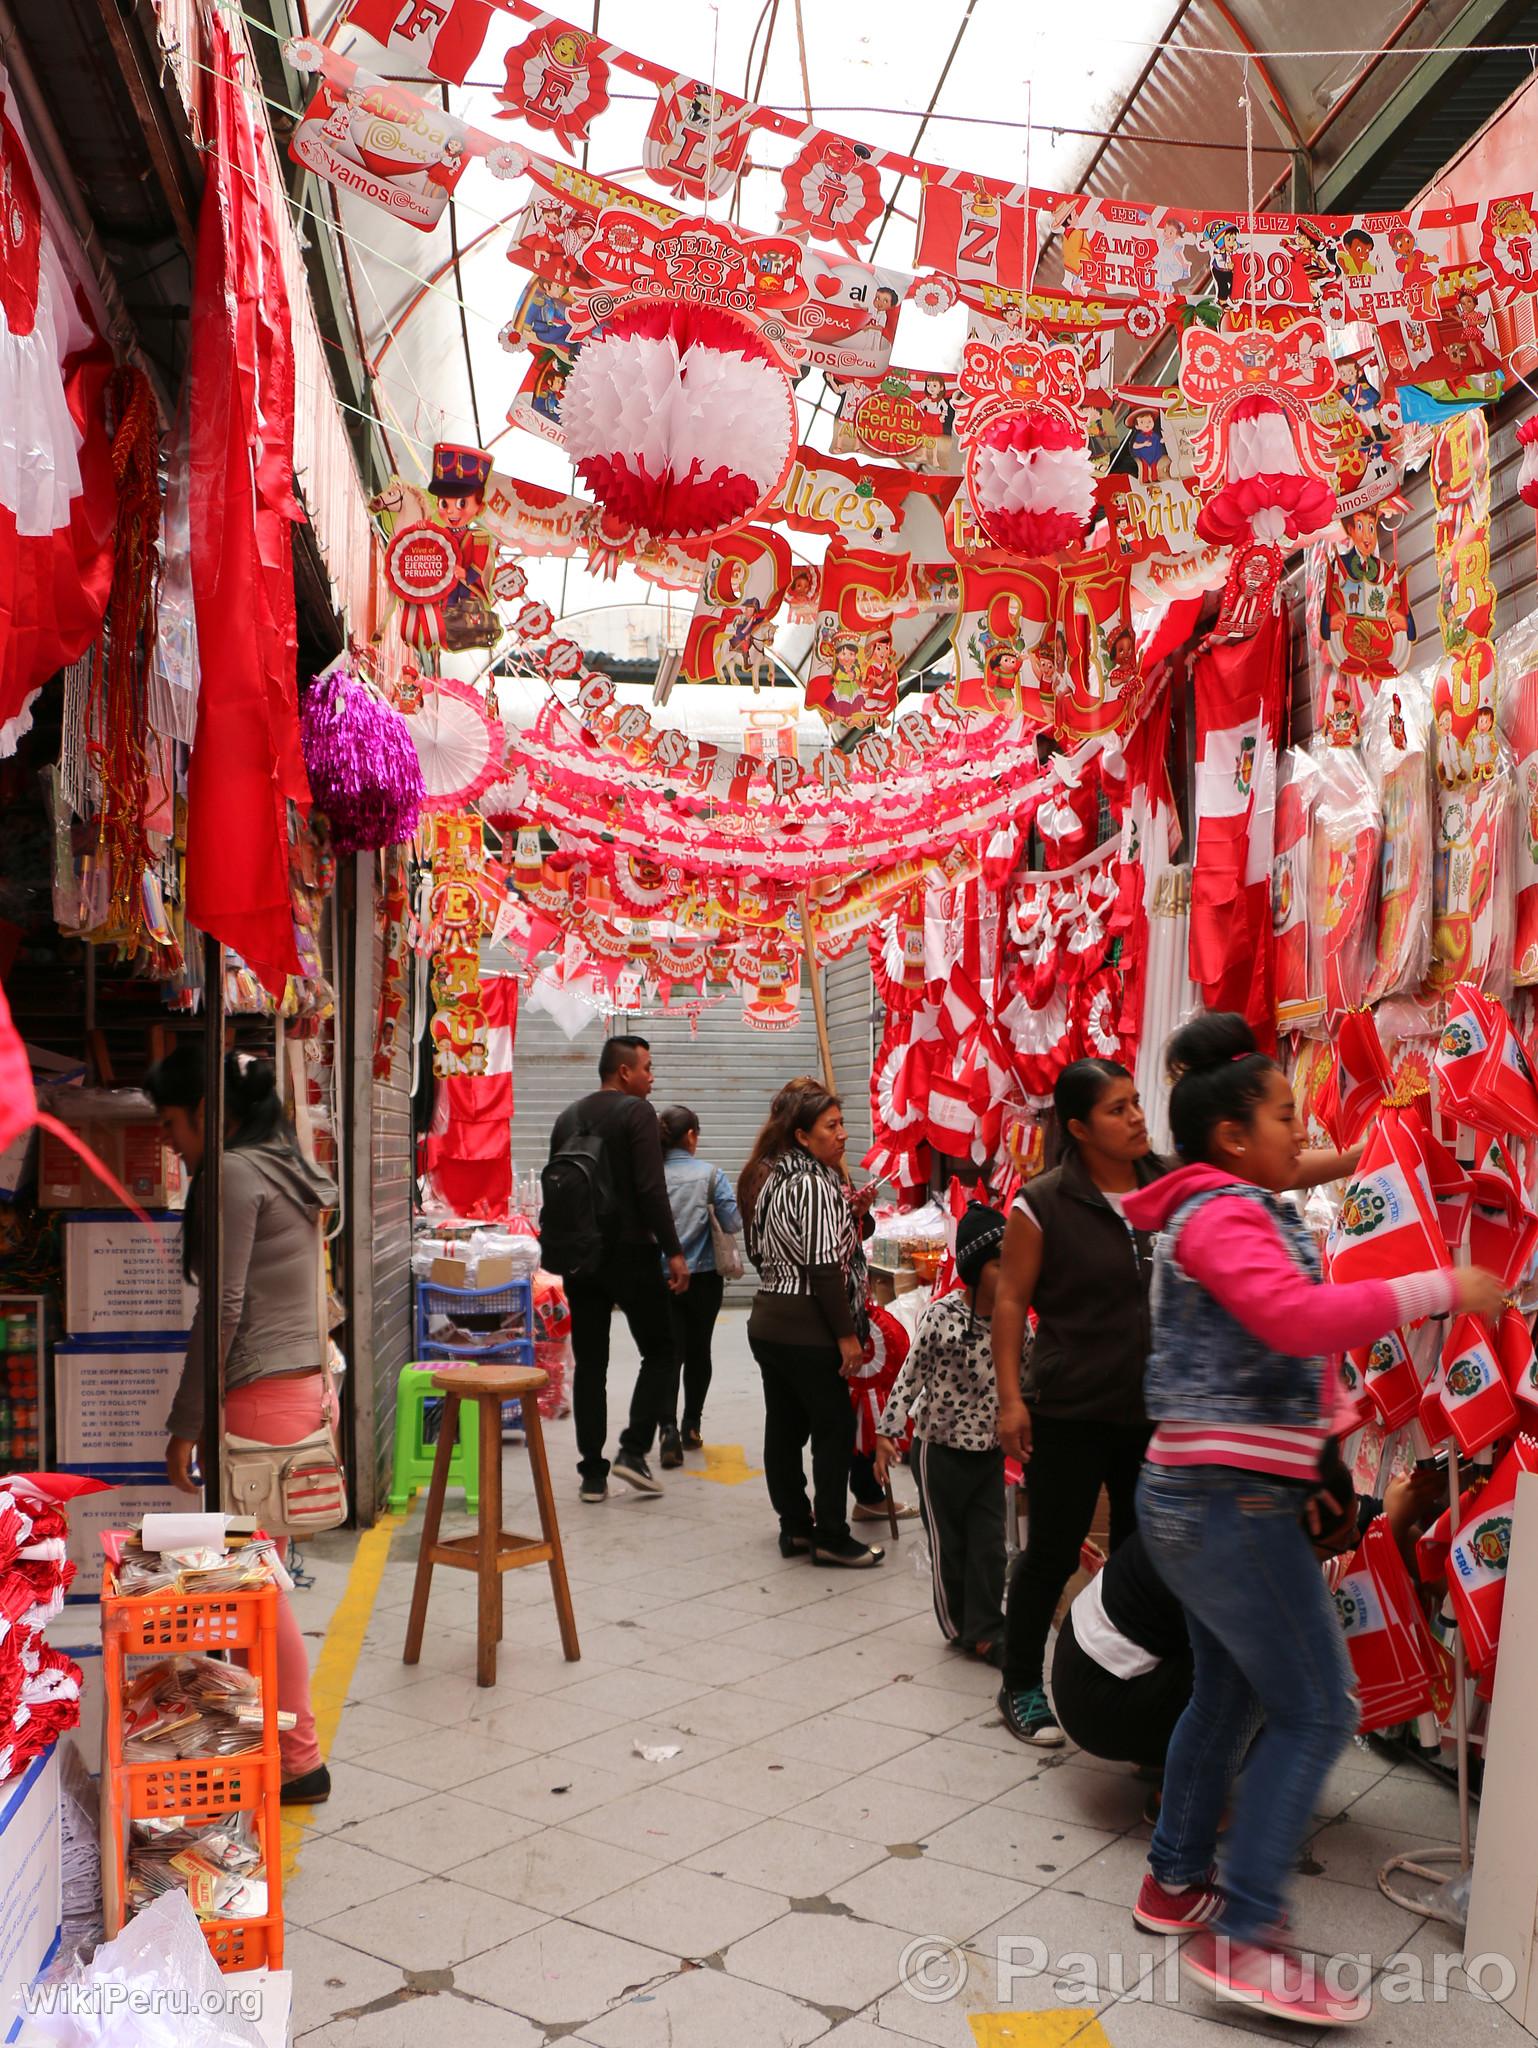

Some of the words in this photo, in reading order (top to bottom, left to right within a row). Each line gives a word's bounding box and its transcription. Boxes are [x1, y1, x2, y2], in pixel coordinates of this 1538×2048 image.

[365, 92, 447, 146] Arriba
[328, 158, 392, 206] vamos
[1111, 206, 1137, 223] TE
[1235, 215, 1290, 231] FELIZ
[1361, 215, 1405, 231] VIVA
[653, 236, 746, 270] ¡FELIZ
[1094, 235, 1150, 259] AMO
[669, 258, 724, 287] 28
[1080, 258, 1158, 292] PERÚ
[1241, 251, 1294, 301] 28
[1349, 274, 1371, 290] EL
[632, 276, 664, 297] de
[667, 281, 757, 313] JULIO!
[849, 284, 868, 303] al
[1359, 283, 1425, 311] PERÚ
[867, 395, 891, 413] De
[894, 399, 916, 417] mi
[901, 418, 922, 432] su
[774, 462, 886, 541] lices
[1335, 492, 1370, 514] amos
[1126, 484, 1204, 544] Patri
[404, 554, 442, 562] GLORIOSO
[404, 561, 442, 570] EJERCITO
[404, 569, 442, 577] PERUANO
[739, 956, 761, 974] GRA
[1454, 1546, 1474, 1577] PERÚ
